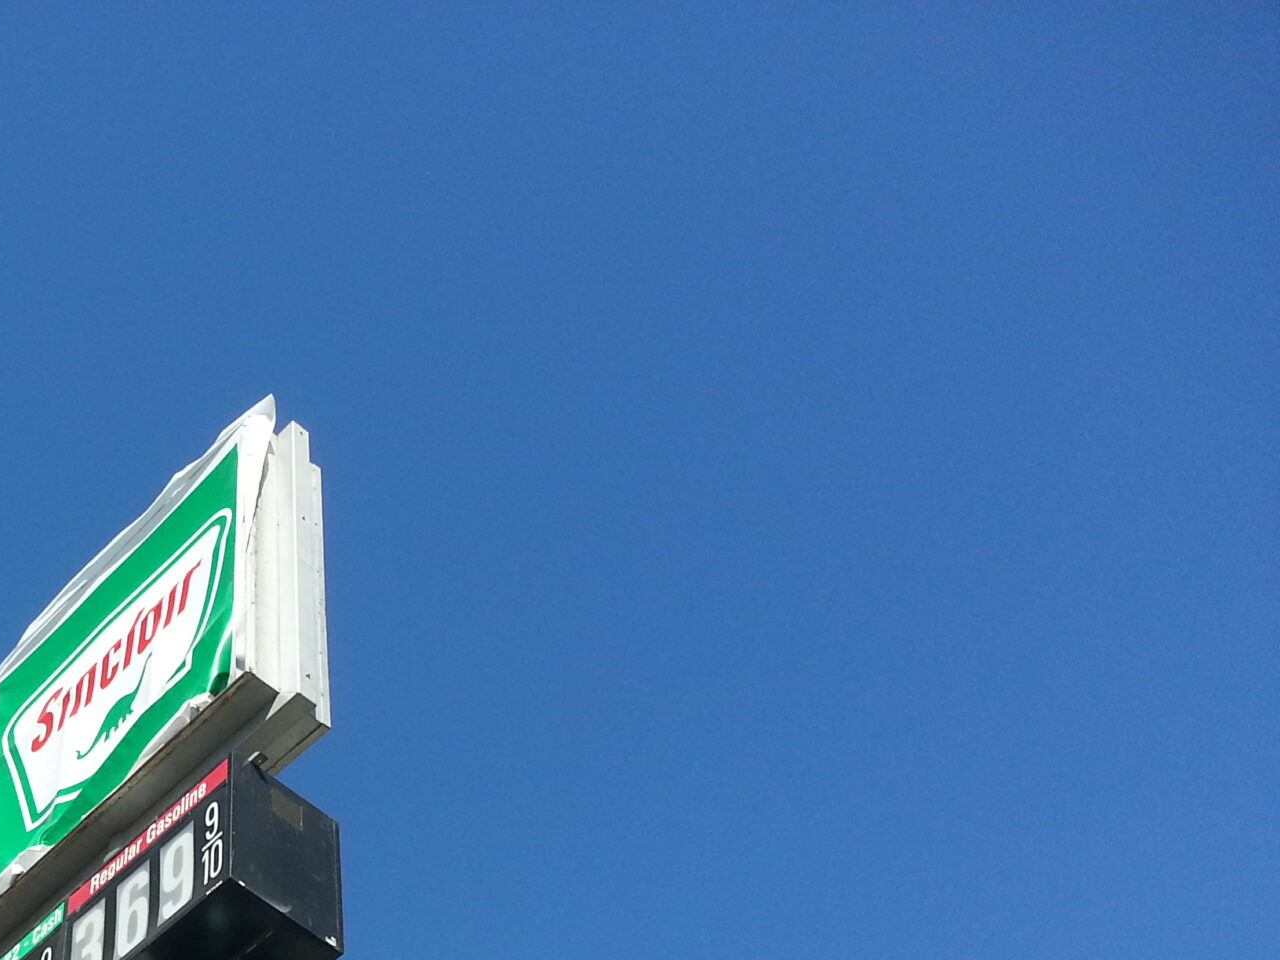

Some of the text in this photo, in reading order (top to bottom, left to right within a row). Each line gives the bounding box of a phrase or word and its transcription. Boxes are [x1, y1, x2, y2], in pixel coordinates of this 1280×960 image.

[31, 558, 203, 753] Sinclair
[89, 782, 207, 895] Regular Gasoline
[32, 907, 62, 944] Cash
